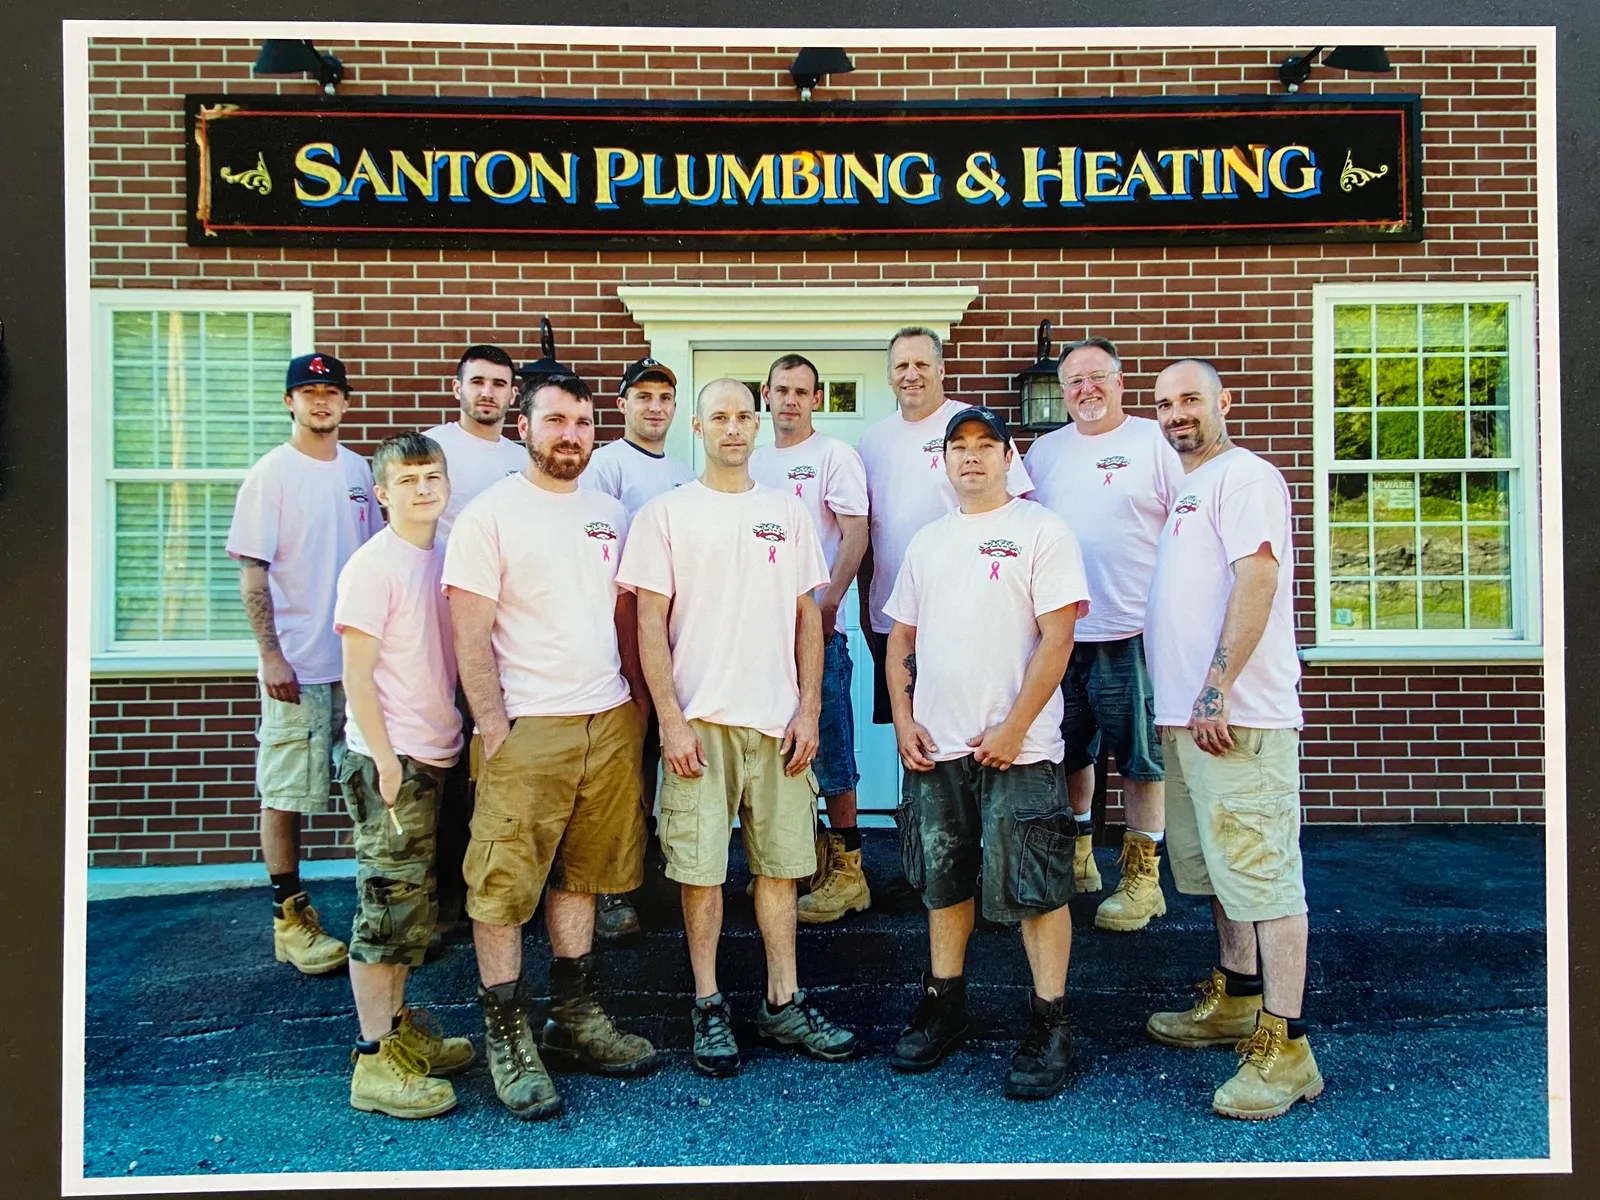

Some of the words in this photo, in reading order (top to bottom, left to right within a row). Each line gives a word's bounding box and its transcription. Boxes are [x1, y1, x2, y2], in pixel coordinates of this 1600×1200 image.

[294, 141, 578, 207] SANTON
[594, 147, 940, 208] PLUMBING
[956, 150, 1010, 207] &
[1021, 143, 1321, 207] HEATING
